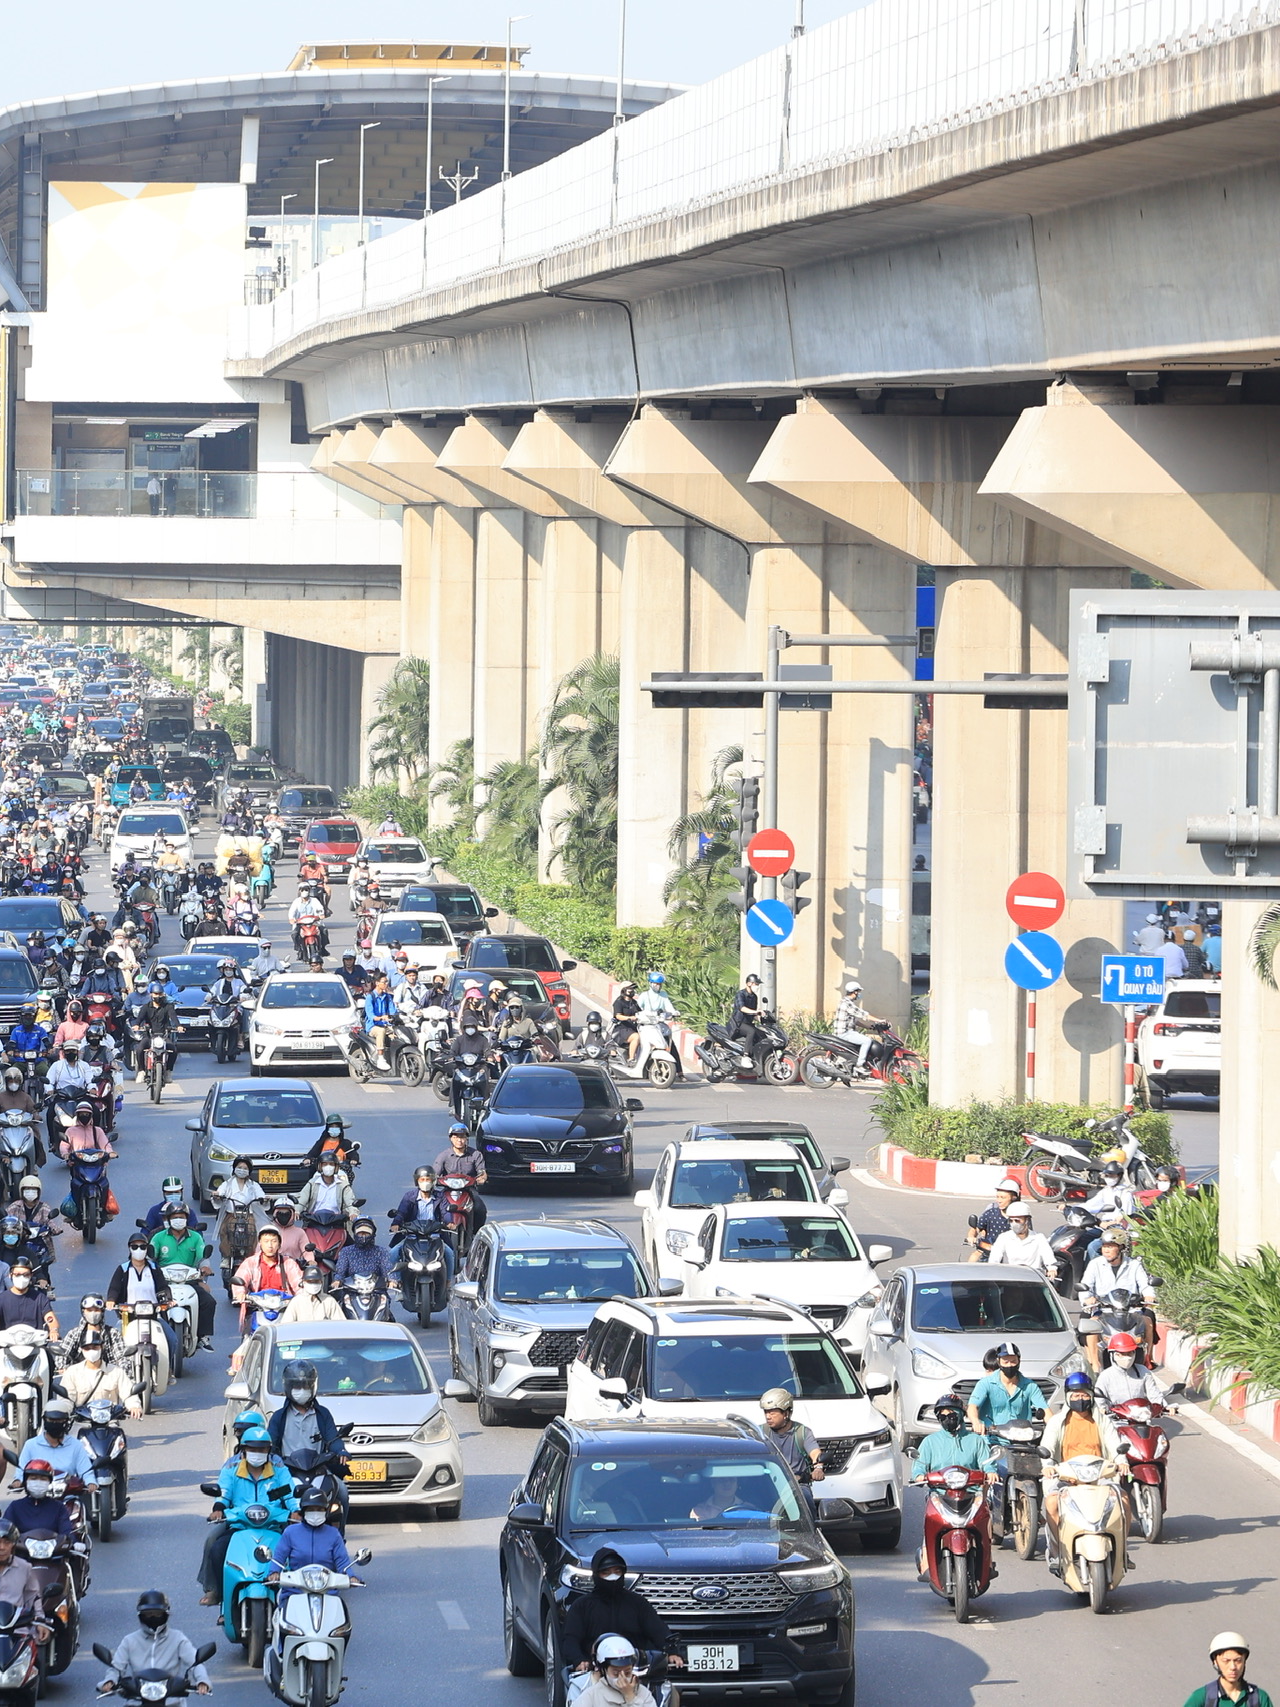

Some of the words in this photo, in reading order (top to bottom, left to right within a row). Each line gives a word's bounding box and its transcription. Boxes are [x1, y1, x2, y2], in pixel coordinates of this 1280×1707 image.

[1135, 964, 1141, 977] Ô
[1142, 964, 1154, 977] TÔ
[1124, 983, 1145, 994] QUAY
[1146, 980, 1163, 995] ĐẦU
[356, 1462, 374, 1470] 30A
[701, 1589, 721, 1598] Ford
[702, 1647, 724, 1658] 30H
[693, 1659, 733, 1670] 583.12
